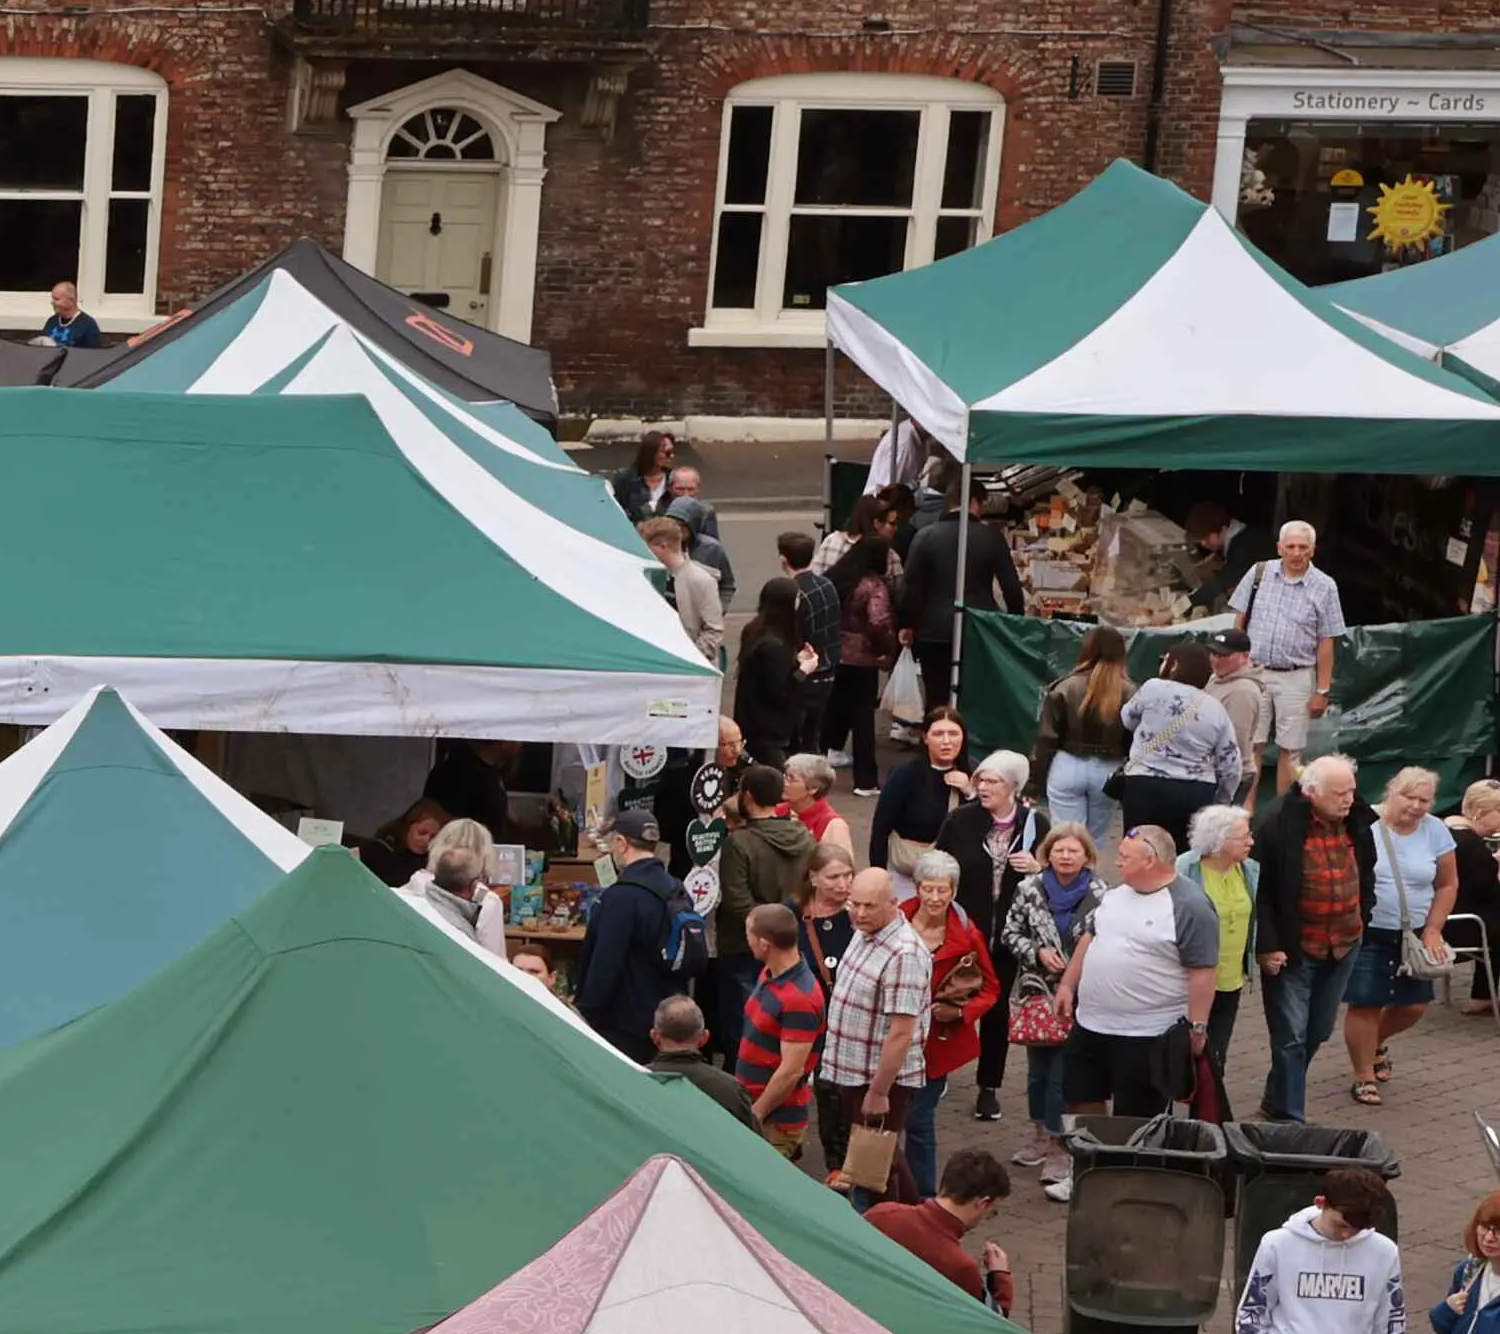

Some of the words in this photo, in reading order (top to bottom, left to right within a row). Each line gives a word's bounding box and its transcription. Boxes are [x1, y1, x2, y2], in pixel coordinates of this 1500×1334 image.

[1293, 92, 1399, 113] Stationery
[1428, 93, 1484, 111] Cards
[1299, 1272, 1364, 1300] MARVEL
